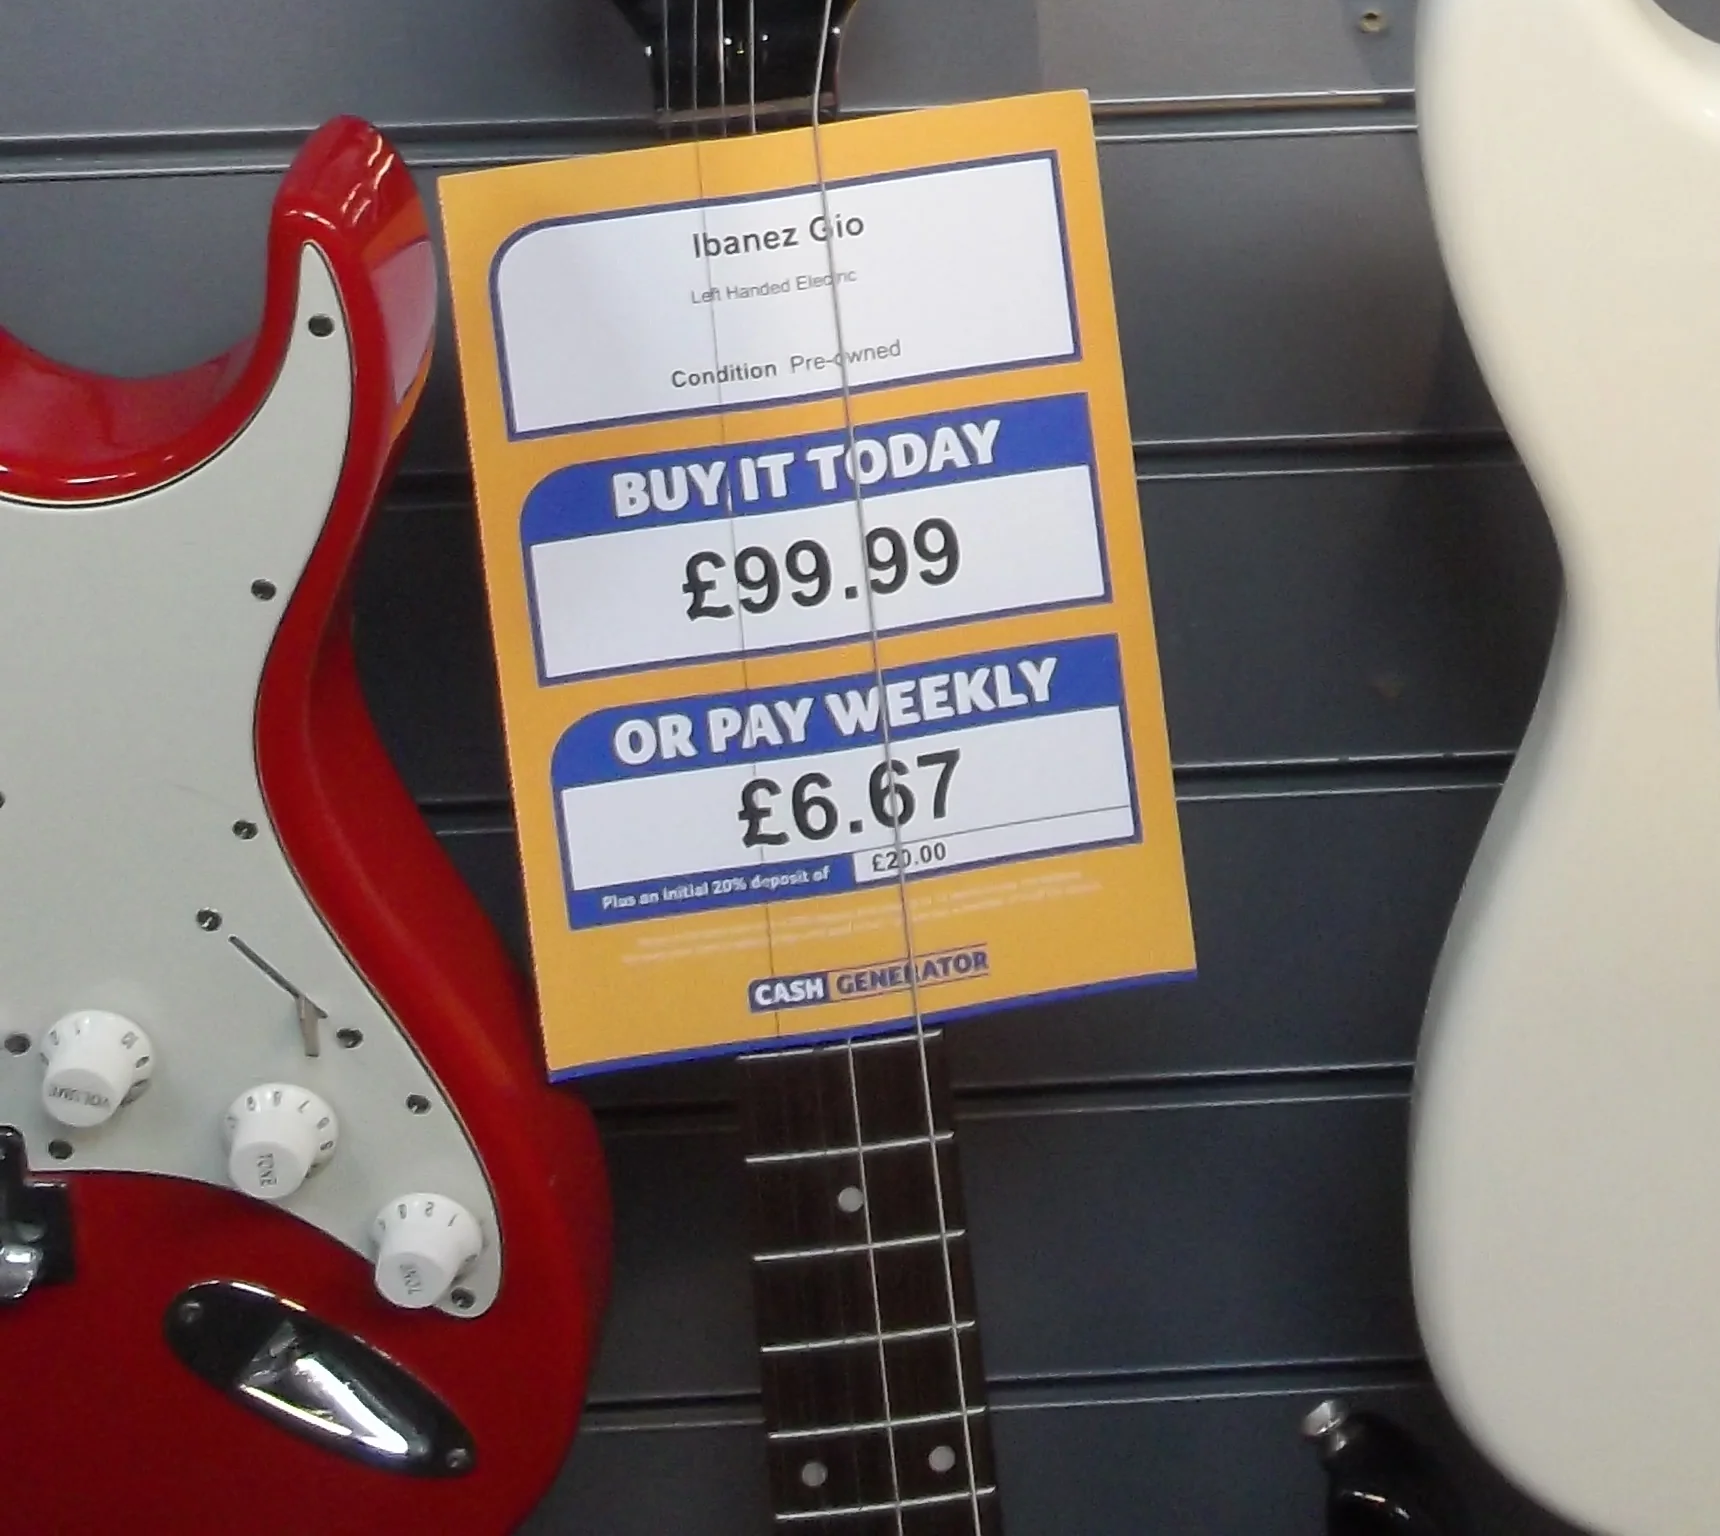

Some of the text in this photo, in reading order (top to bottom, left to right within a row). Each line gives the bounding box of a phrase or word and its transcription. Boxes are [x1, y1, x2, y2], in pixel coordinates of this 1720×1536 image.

[693, 214, 864, 258] Ibanez Gio
[691, 270, 857, 304] Left Handed Elecric
[671, 339, 901, 388] Condition Pre-owned
[612, 420, 1001, 519] BUY IT TODAY
[681, 516, 961, 623] £99.99
[614, 657, 1058, 767] OR PAY WEEKLY
[737, 748, 961, 848] £6.67
[602, 843, 946, 910] Plus an initial 20% deposit of £20.00
[755, 951, 989, 1006] CASH GENERATOR
